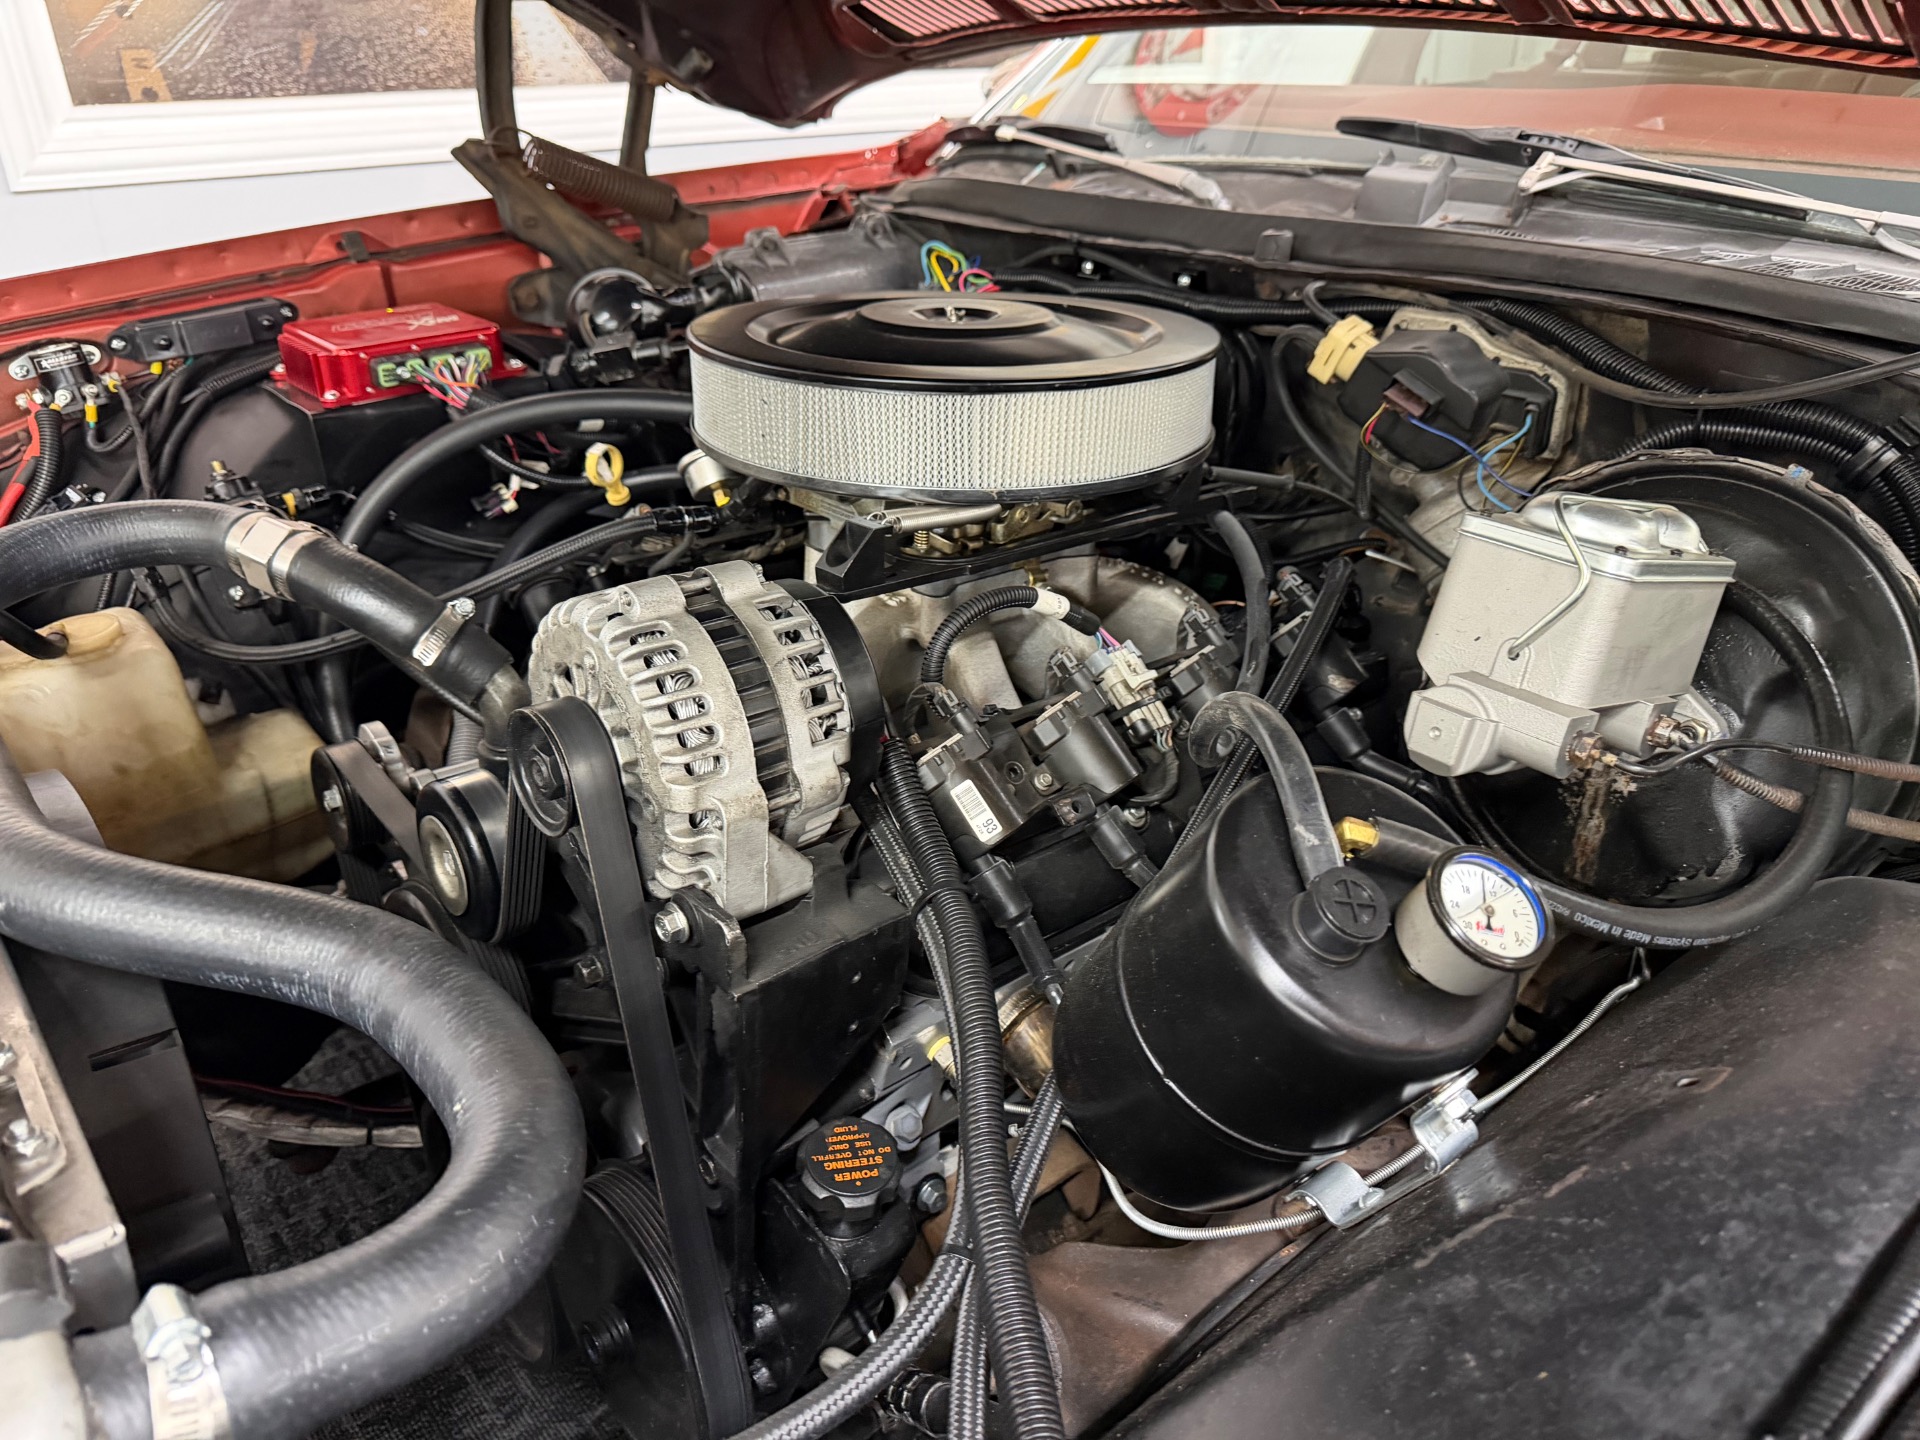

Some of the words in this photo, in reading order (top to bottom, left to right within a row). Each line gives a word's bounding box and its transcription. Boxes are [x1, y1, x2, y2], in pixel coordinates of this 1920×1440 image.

[982, 818, 998, 834] 93
[1461, 884, 1471, 895] 18
[1450, 899, 1461, 909] 24
[1462, 920, 1473, 930] 30
[1574, 912, 1610, 933] Mexico
[1611, 925, 1622, 937] in
[1623, 929, 1651, 944] Made
[1652, 936, 1693, 947] Systems
[834, 1125, 858, 1133] FLUID
[828, 1143, 849, 1151] ONLY
[811, 1152, 852, 1162] OVERFILL
[824, 1156, 883, 1170] STEERING
[834, 1168, 879, 1181] POWER
